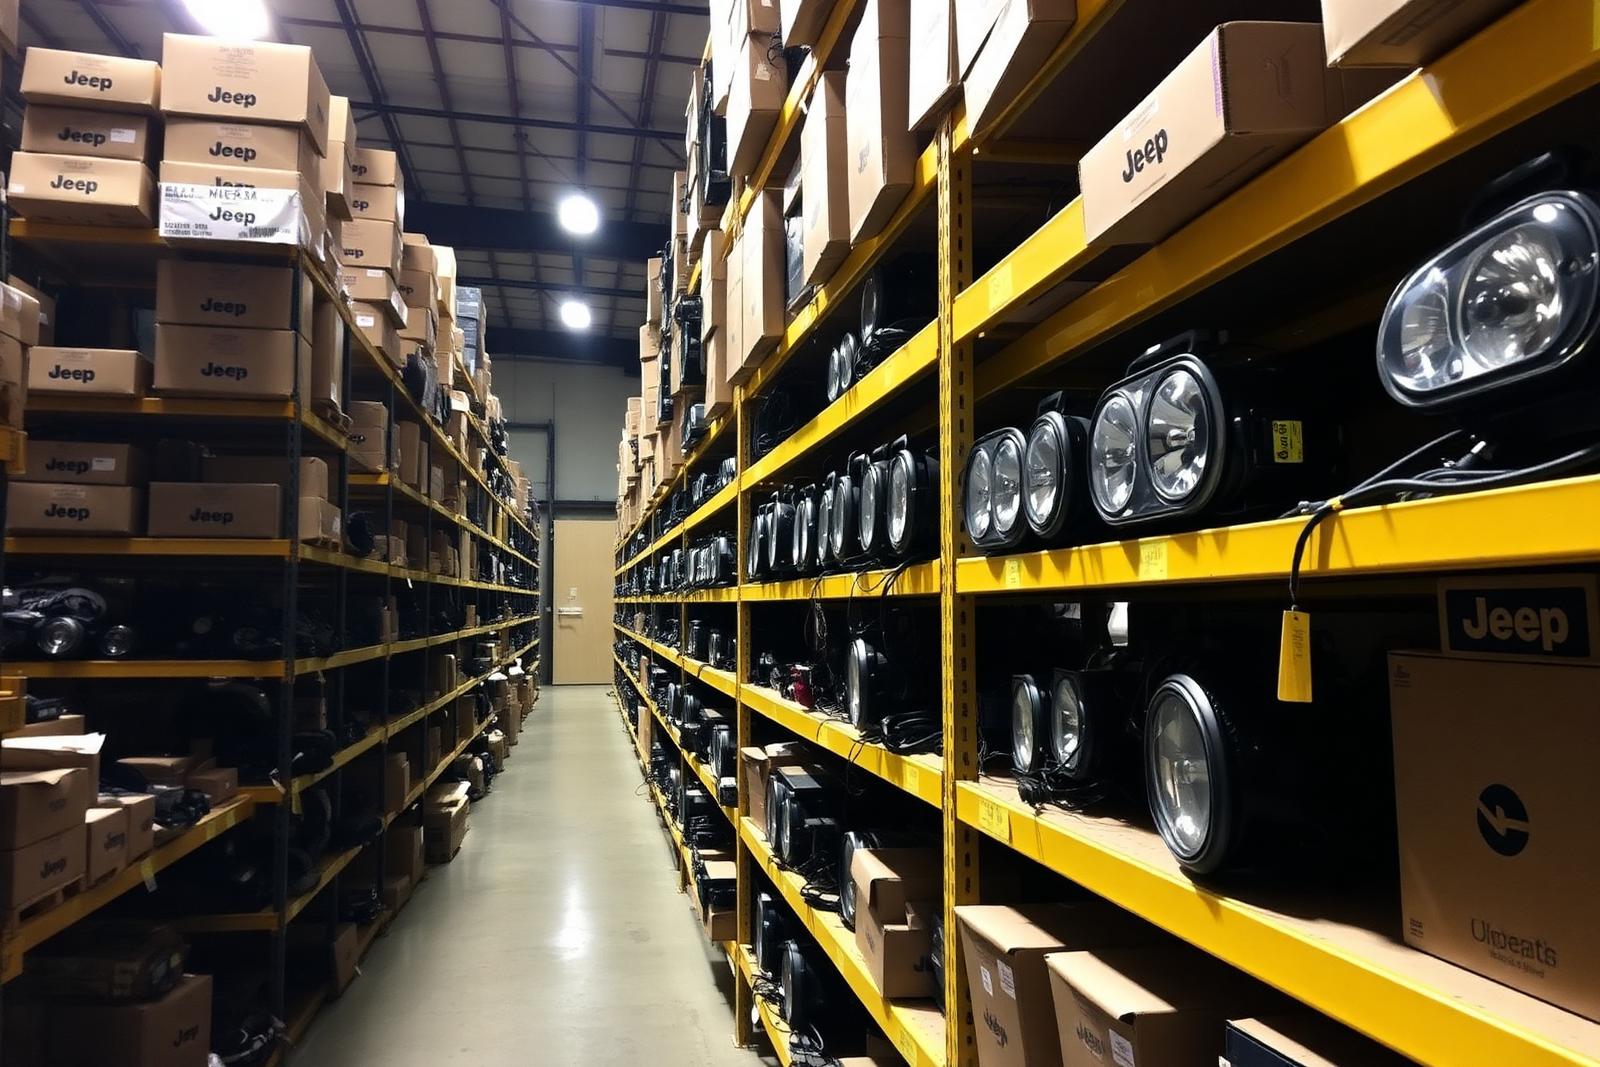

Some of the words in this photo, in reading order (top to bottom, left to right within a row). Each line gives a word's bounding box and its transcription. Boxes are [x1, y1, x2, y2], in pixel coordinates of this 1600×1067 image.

[64, 70, 113, 91] Jeep
[207, 87, 257, 107] Jeep
[58, 127, 106, 147] Jeep
[209, 141, 257, 161] Jeep
[1122, 128, 1168, 183] Jeep
[50, 175, 98, 194] Jeep
[209, 206, 256, 226] Jeep
[201, 298, 247, 317] Jeep
[48, 364, 95, 383] Jeep
[201, 362, 248, 381] Jeep
[45, 457, 90, 475] Jeep
[44, 503, 90, 521] Jeep
[189, 507, 234, 526] Jeep
[1461, 595, 1569, 652] Jeep
